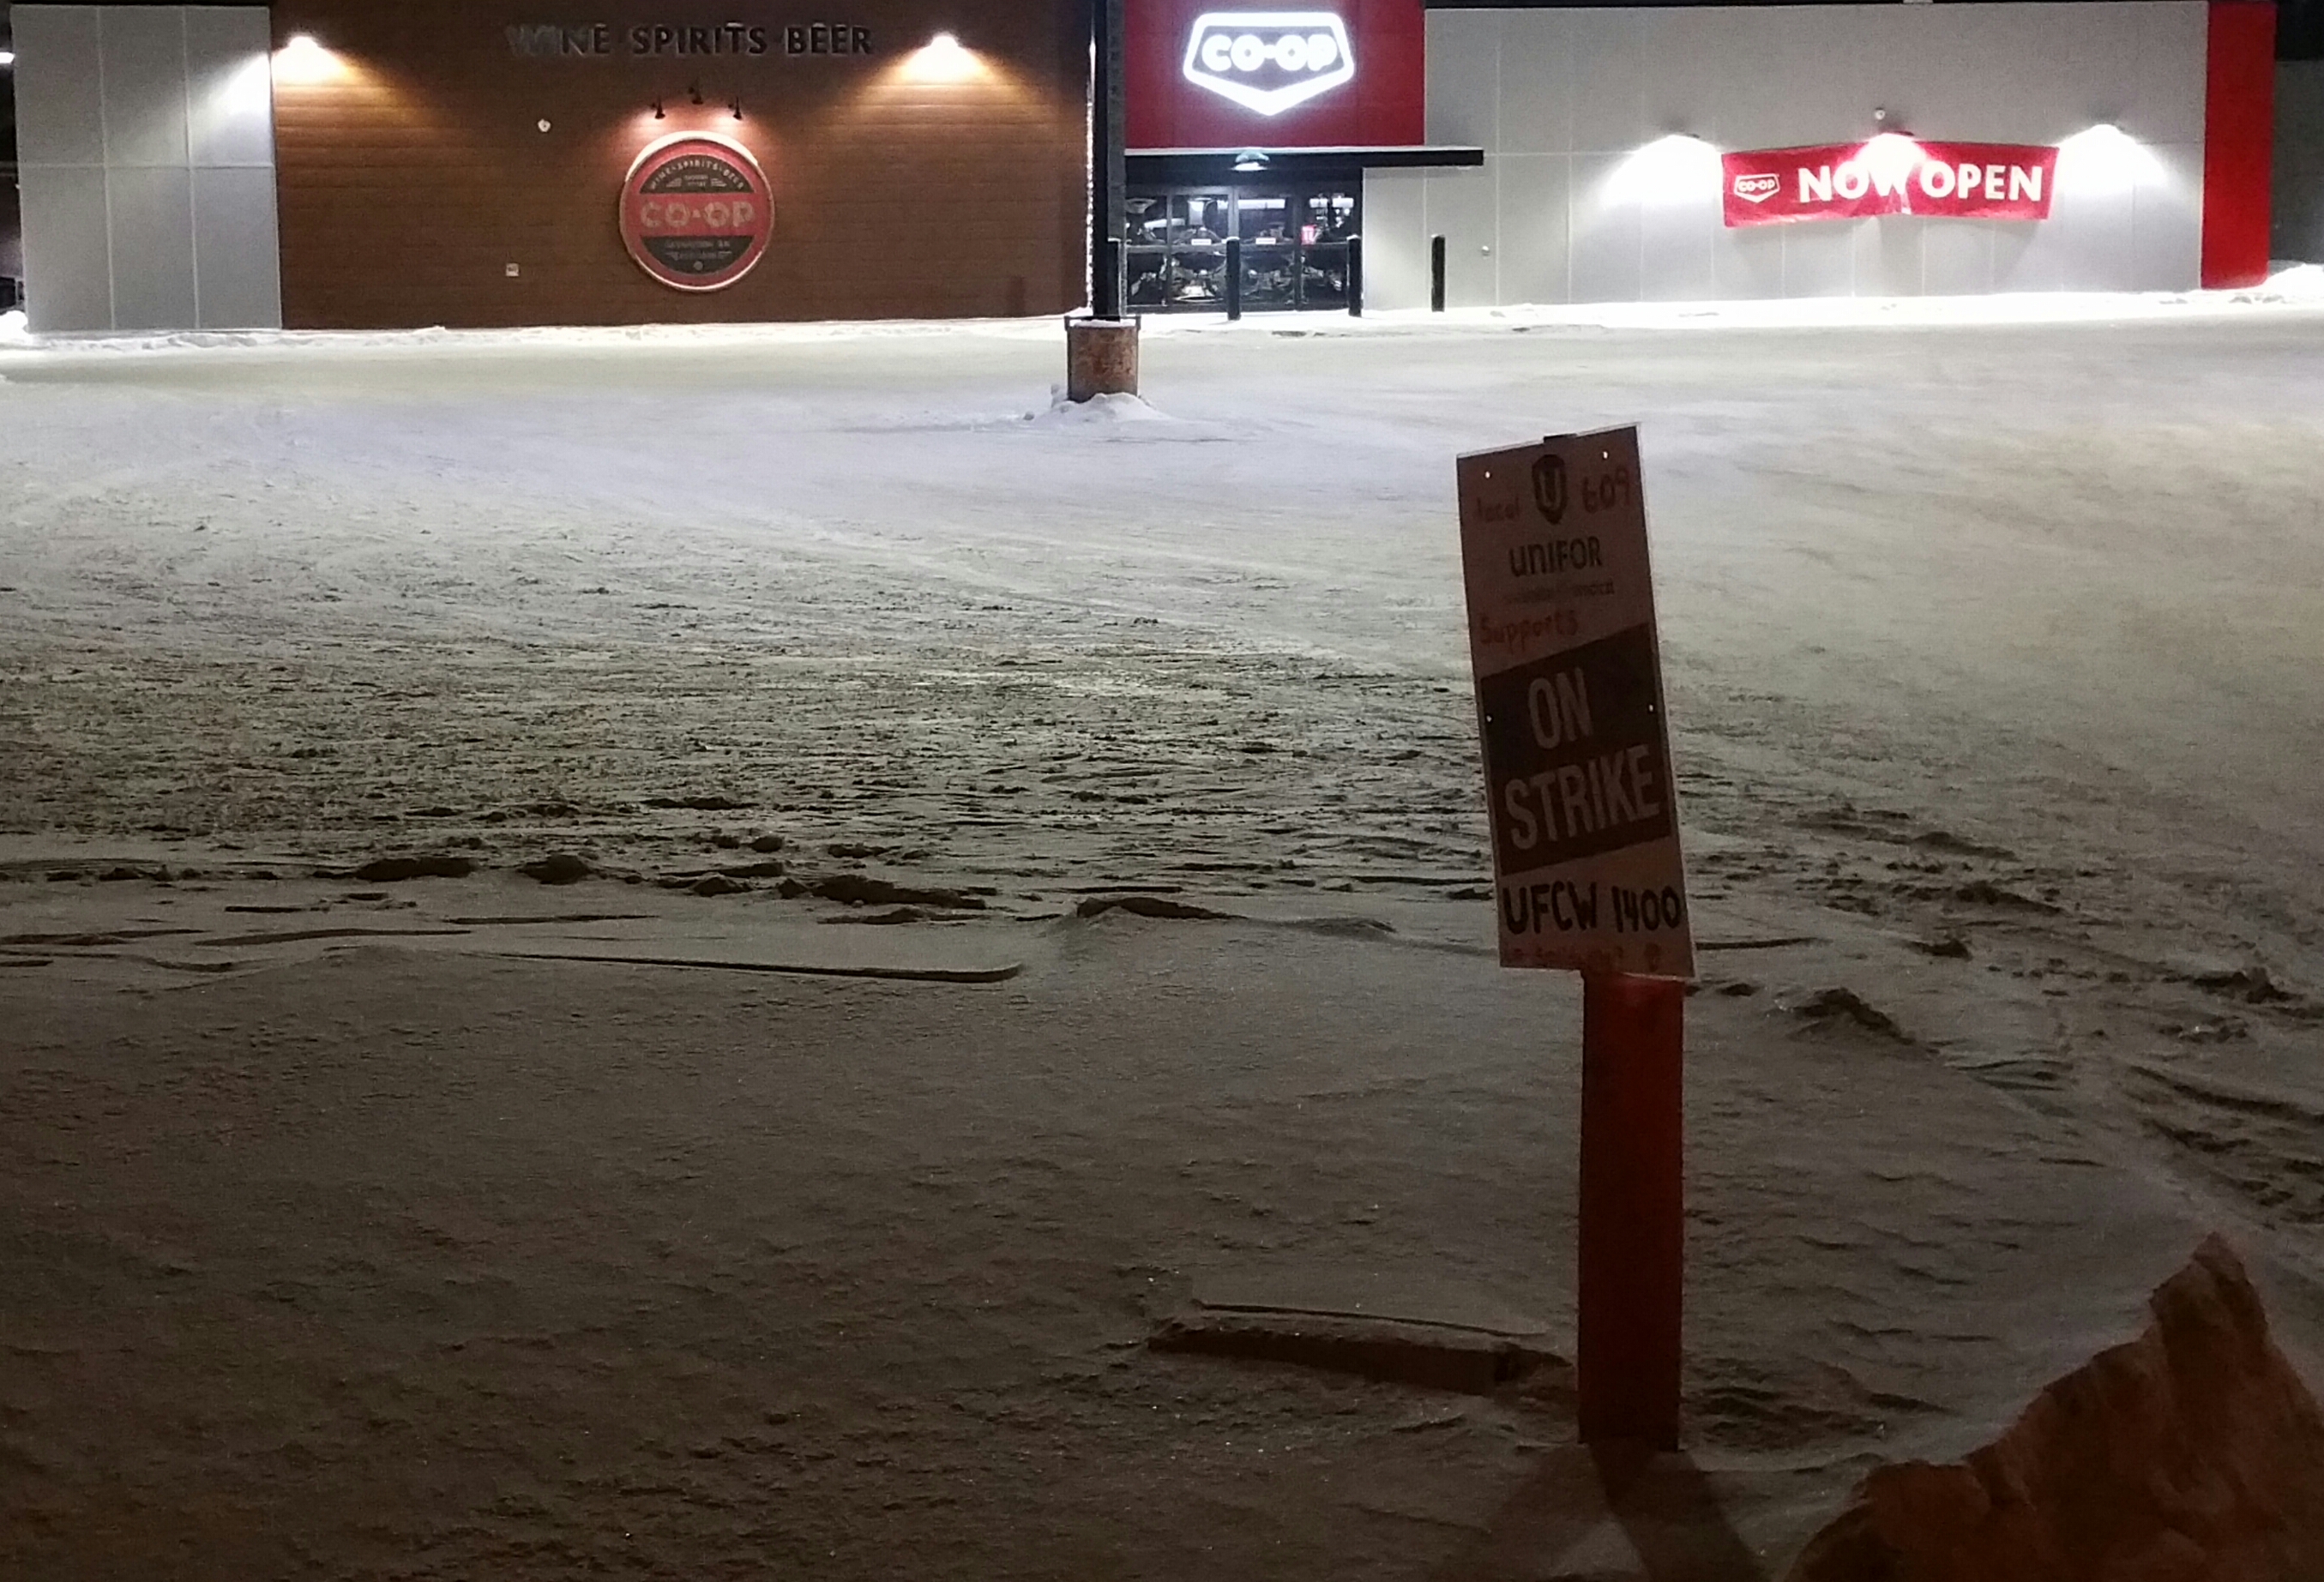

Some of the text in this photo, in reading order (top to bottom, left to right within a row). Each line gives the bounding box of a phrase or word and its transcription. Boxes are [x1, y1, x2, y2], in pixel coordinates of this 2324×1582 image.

[632, 22, 768, 57] SPIRITS
[786, 22, 874, 56] BEER
[1201, 34, 1337, 71] CO-OP
[1738, 160, 2043, 203] CO-OP NOW OPEN
[1528, 667, 1592, 749] ON
[1505, 743, 1659, 850] STRIKE
[1502, 881, 1681, 935] UFCW 1400
